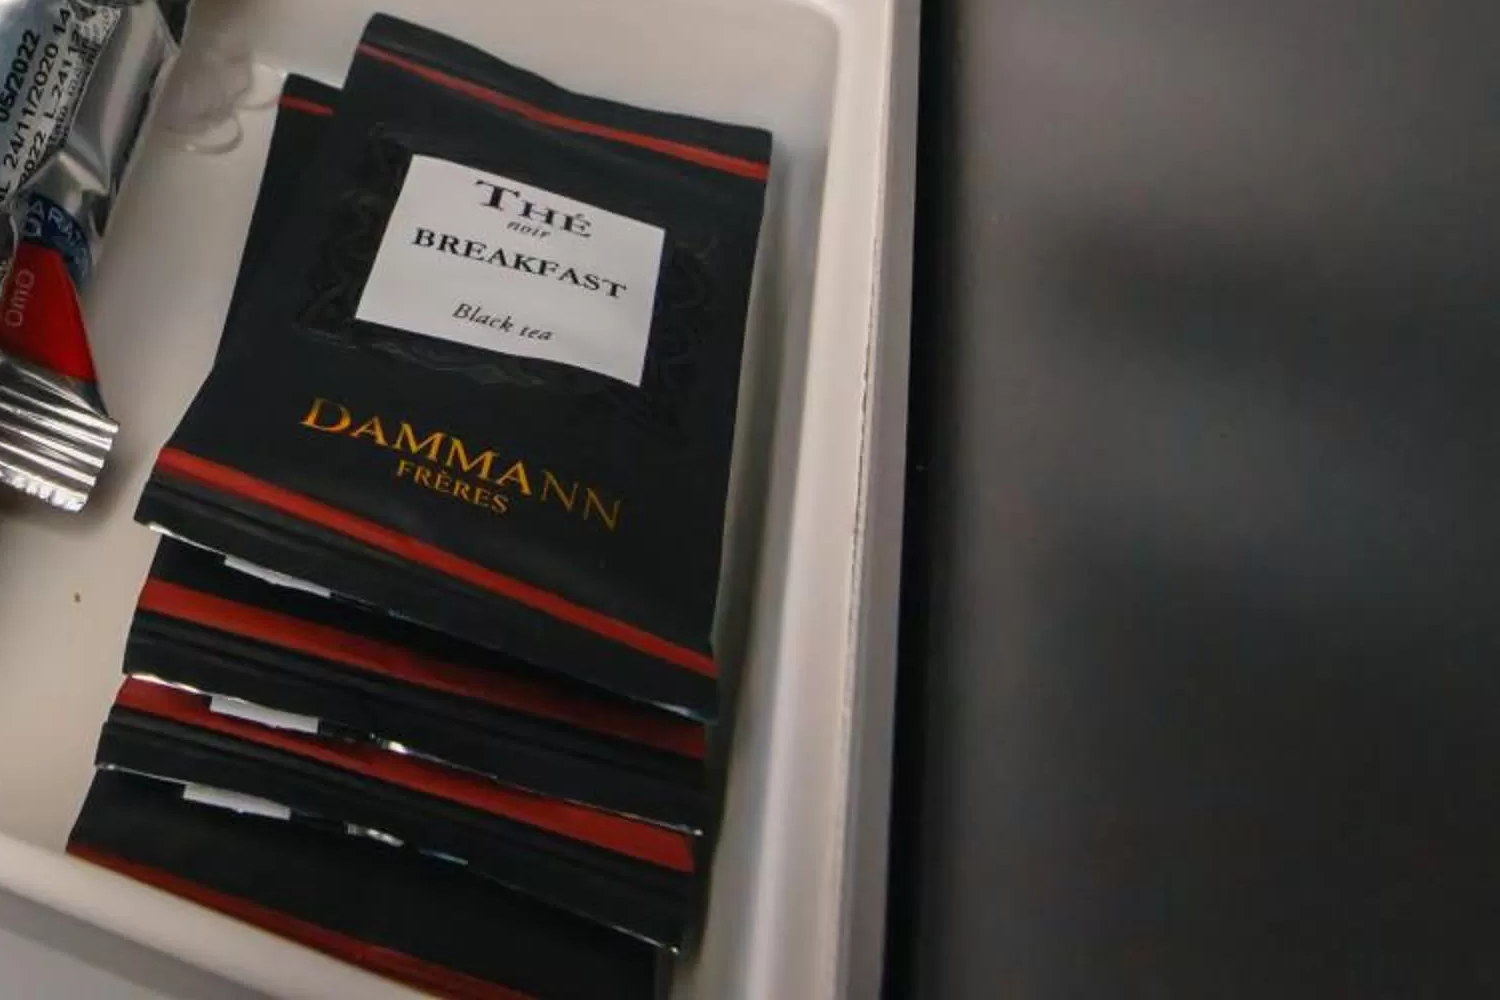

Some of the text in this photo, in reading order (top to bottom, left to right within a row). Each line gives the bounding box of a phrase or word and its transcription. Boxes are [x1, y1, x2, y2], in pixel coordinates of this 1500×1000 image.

[3, 41, 60, 170] 24/11/2020
[473, 178, 594, 240] THÉ
[506, 218, 553, 241] noir
[410, 227, 628, 300] BREAKFAST
[451, 301, 554, 343] Black tea
[300, 396, 622, 533] DAMMANN
